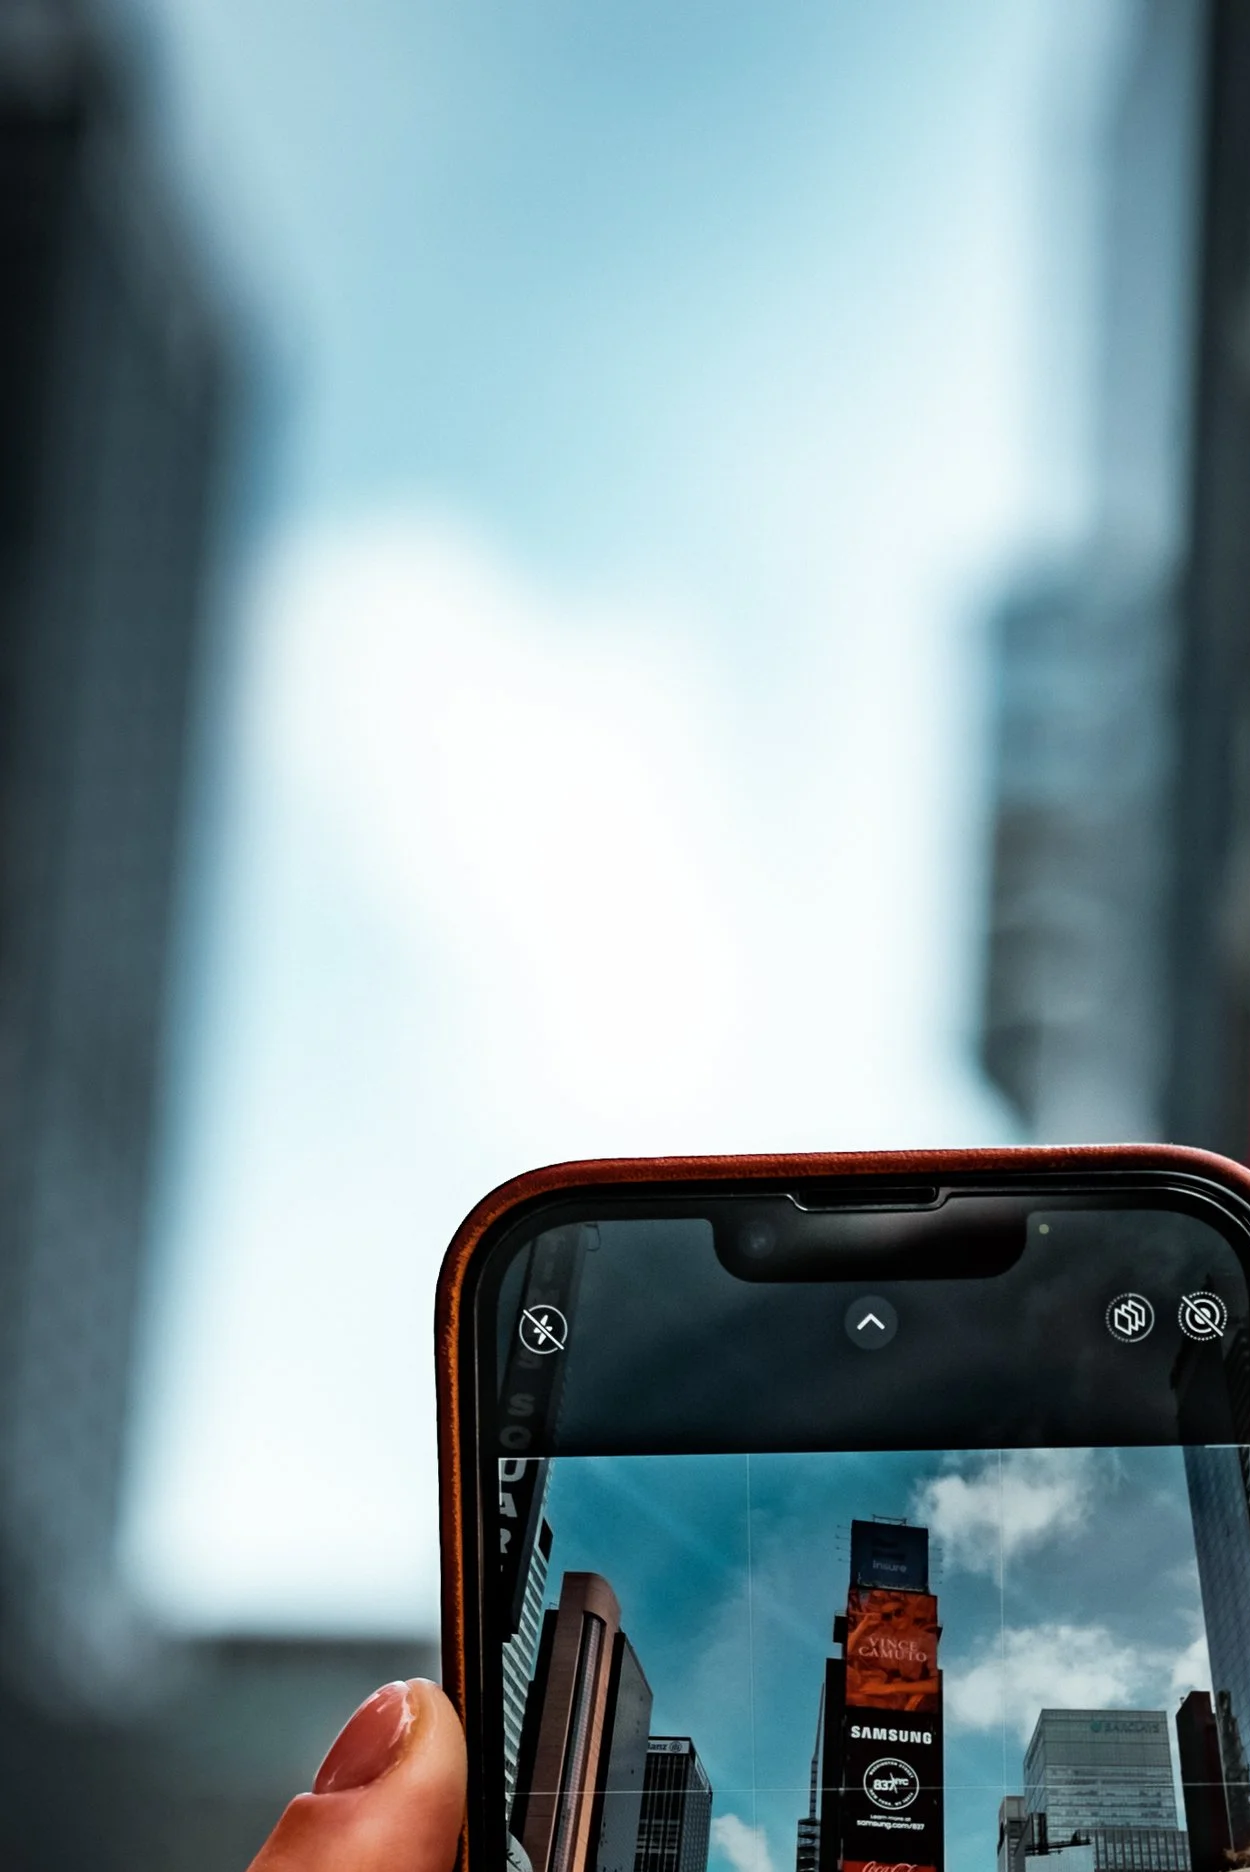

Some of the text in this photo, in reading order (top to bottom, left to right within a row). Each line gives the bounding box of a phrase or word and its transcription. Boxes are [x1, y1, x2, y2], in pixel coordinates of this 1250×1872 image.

[498, 1392, 537, 1573] SQUAR
[869, 1637, 918, 1650] VINCE
[858, 1647, 927, 1662] CAMUTO
[851, 1725, 932, 1745] SAMSUNG
[873, 1779, 895, 1791] 837
[856, 1819, 925, 1831] samsung.com/837
